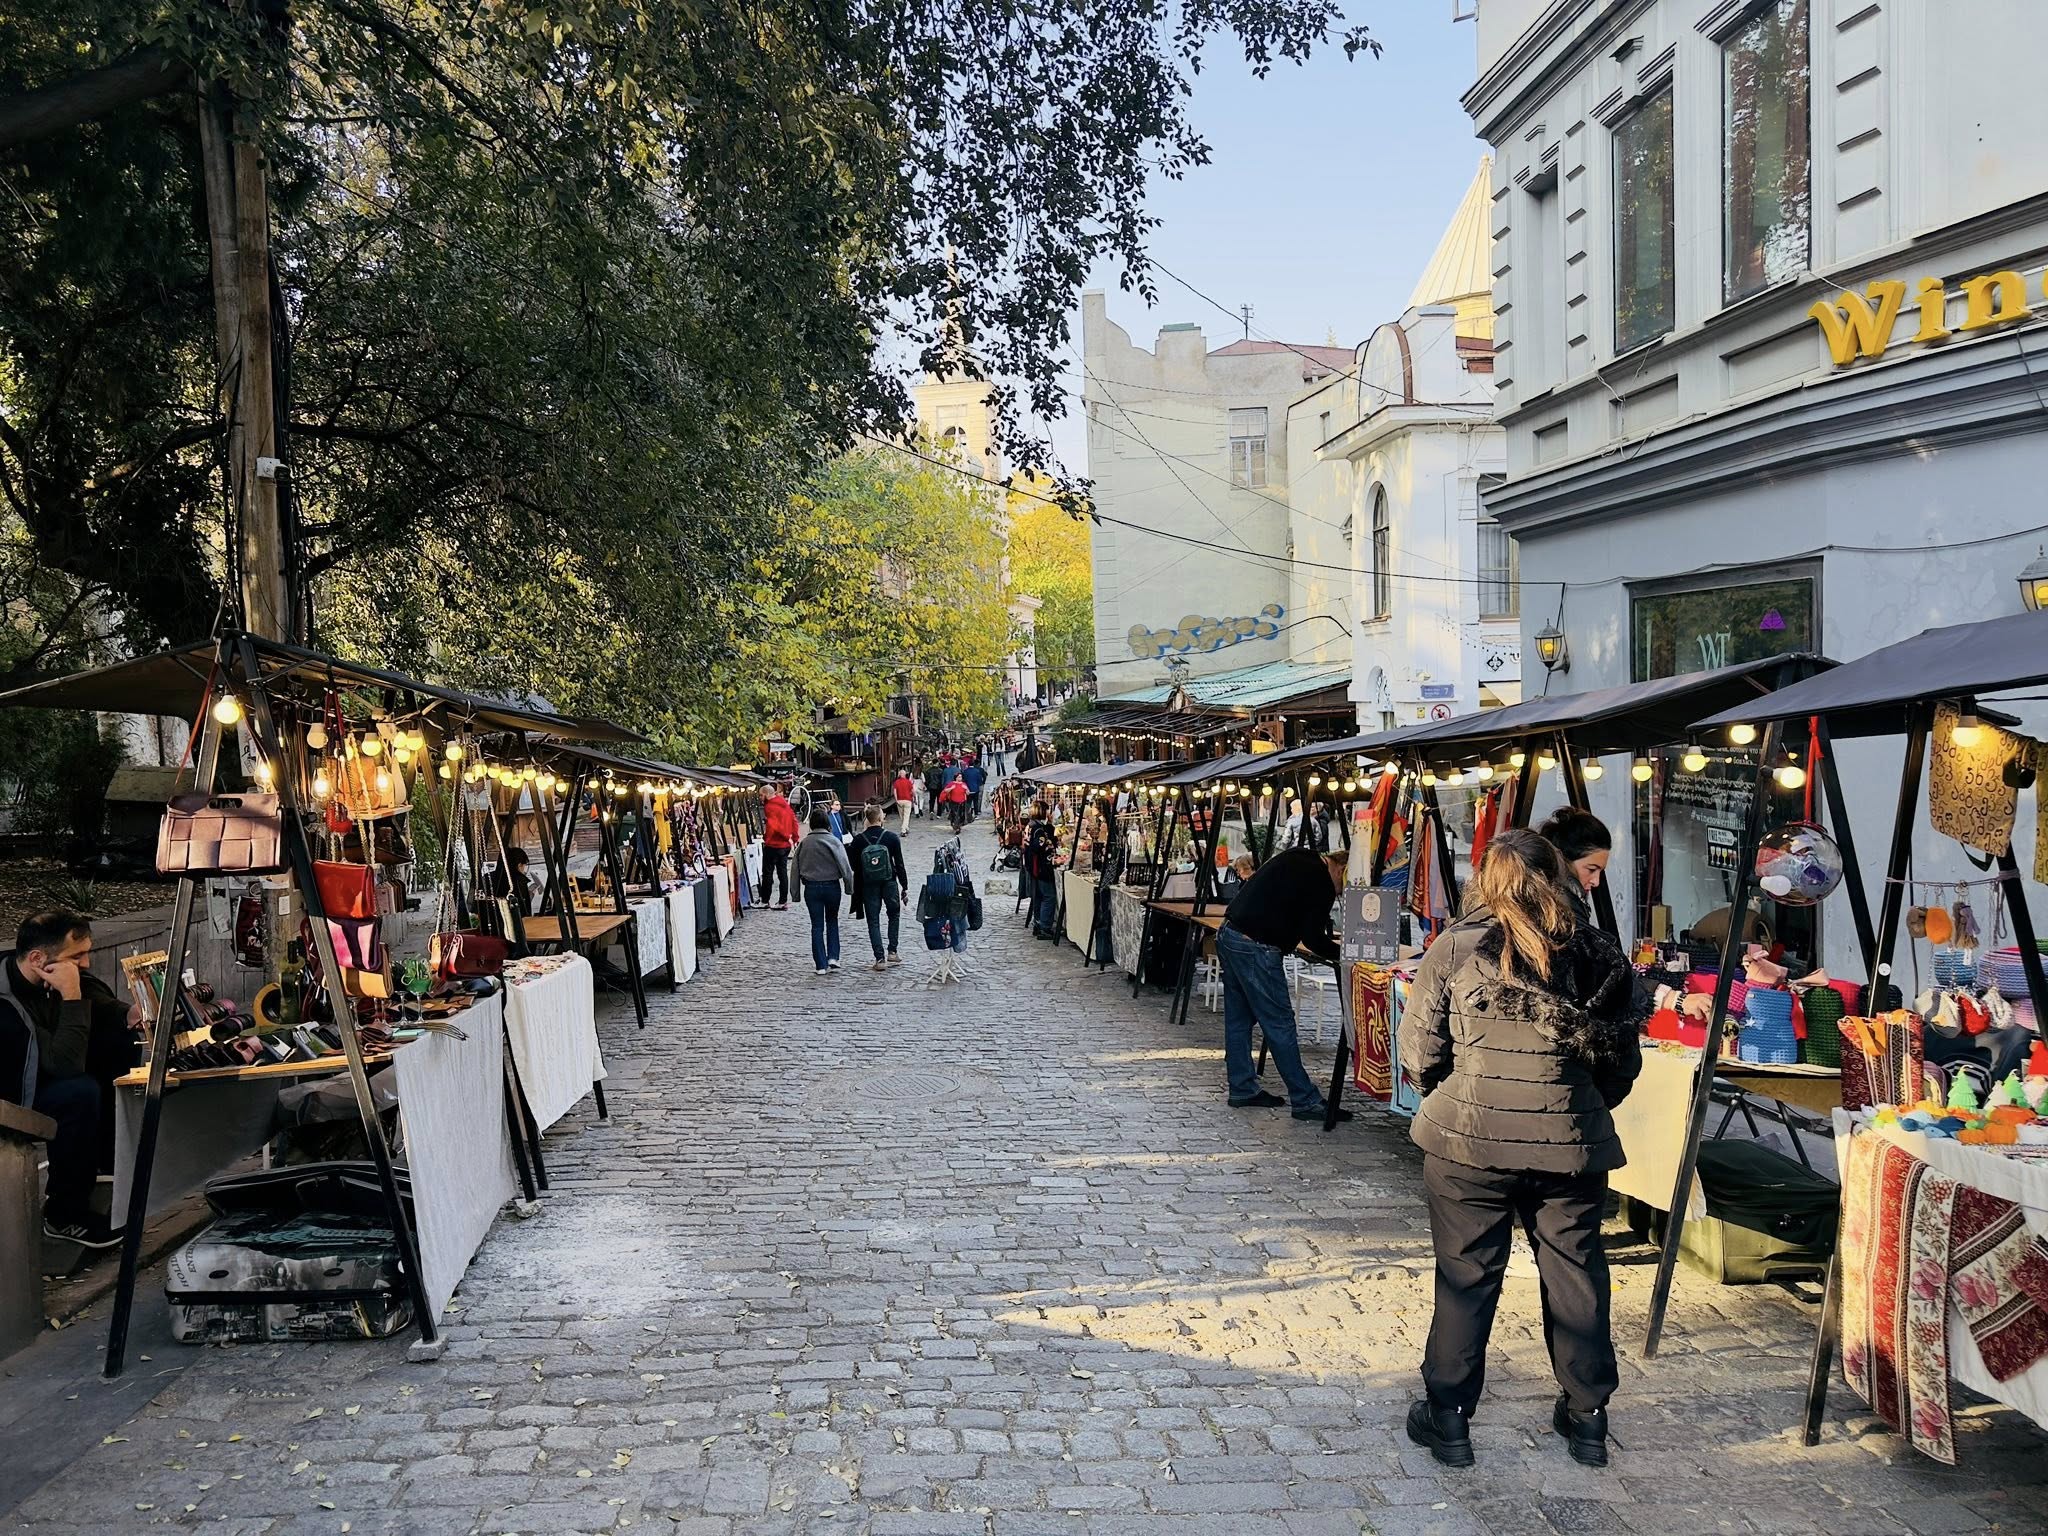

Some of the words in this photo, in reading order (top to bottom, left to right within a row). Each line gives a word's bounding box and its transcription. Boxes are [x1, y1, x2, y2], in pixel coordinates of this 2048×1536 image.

[1808, 270, 2048, 365] Win
[1696, 630, 1731, 670] WT
[170, 1256, 189, 1287] HOLID
